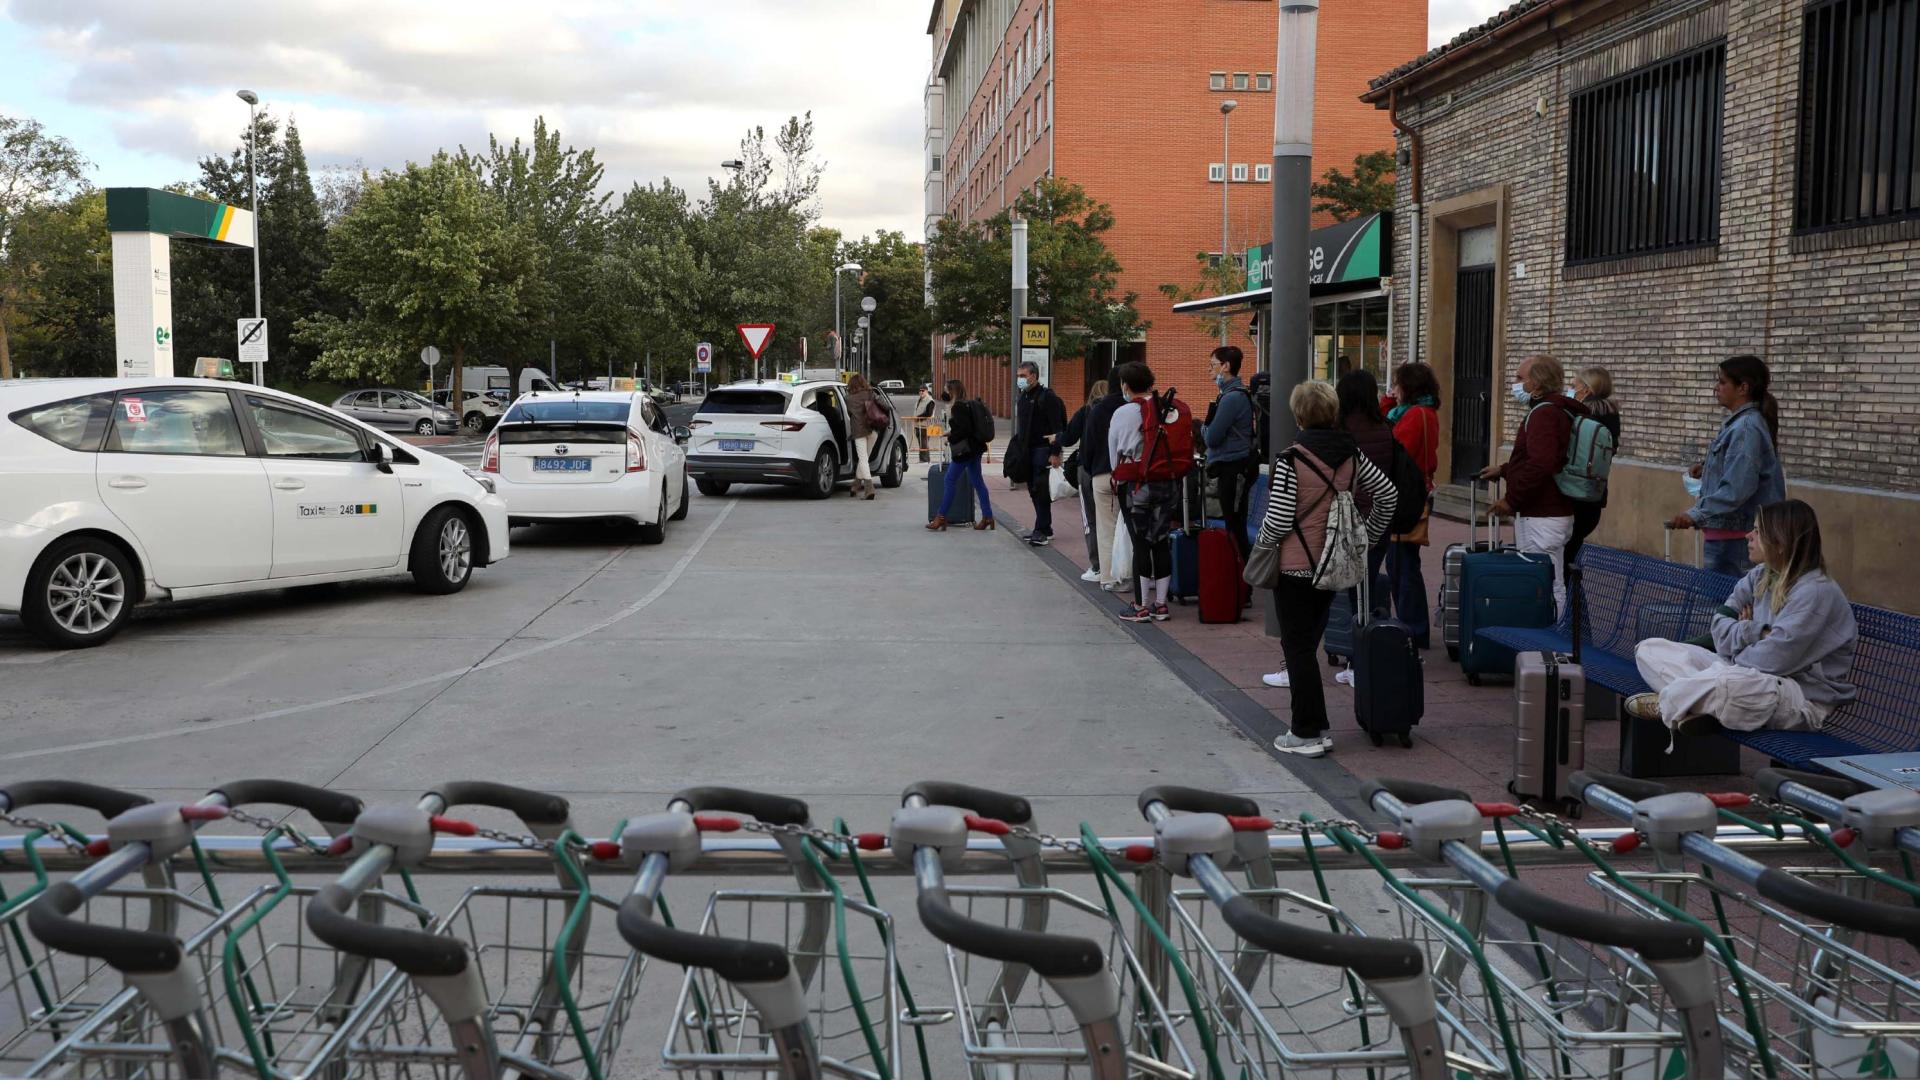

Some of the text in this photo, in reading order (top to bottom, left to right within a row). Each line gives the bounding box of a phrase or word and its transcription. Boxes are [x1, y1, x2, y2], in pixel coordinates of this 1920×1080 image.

[1026, 330, 1046, 339] TAXI
[540, 460, 587, 470] 8492 JDF
[299, 505, 318, 516] Taxi
[340, 504, 355, 514] 248
